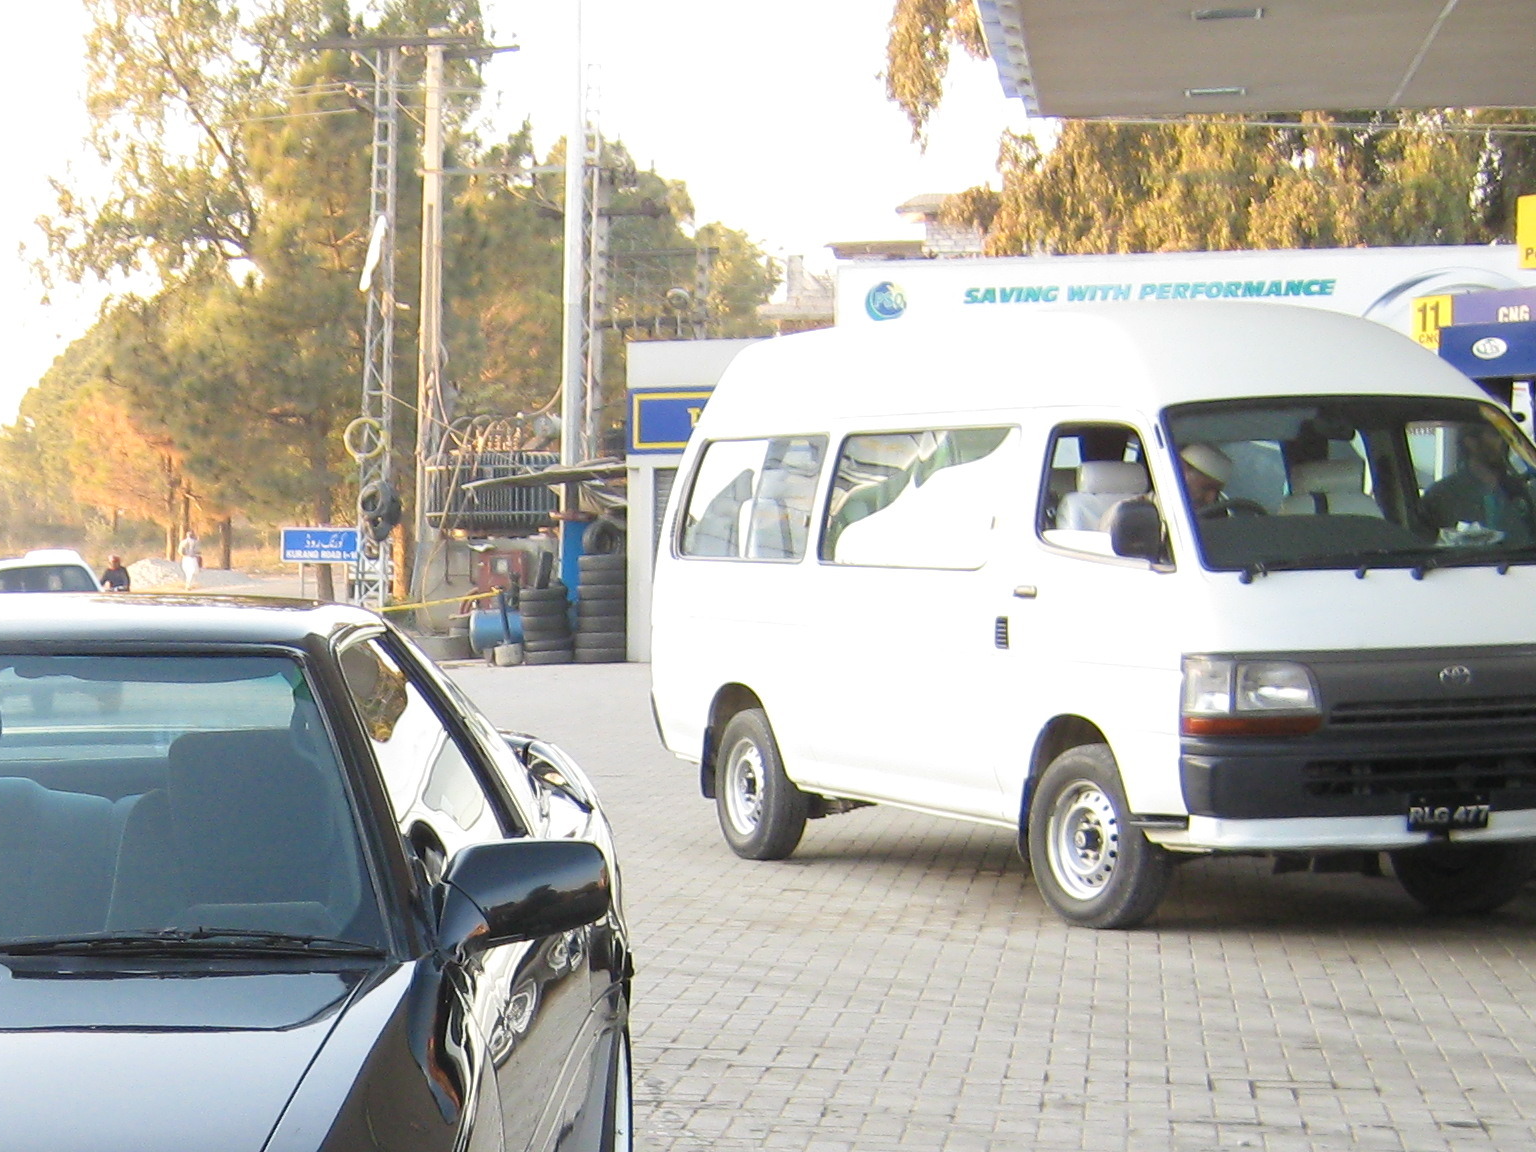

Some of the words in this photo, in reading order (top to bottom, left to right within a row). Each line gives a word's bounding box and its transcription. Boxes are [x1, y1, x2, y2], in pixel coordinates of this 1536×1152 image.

[963, 285, 1060, 304] SAVING
[1067, 283, 1132, 302] WITH
[1138, 277, 1337, 300] PERFORMANCE
[1417, 301, 1439, 331] 11
[1498, 304, 1530, 322] CNG
[320, 549, 342, 559] ROAD
[1453, 805, 1490, 823] 477
